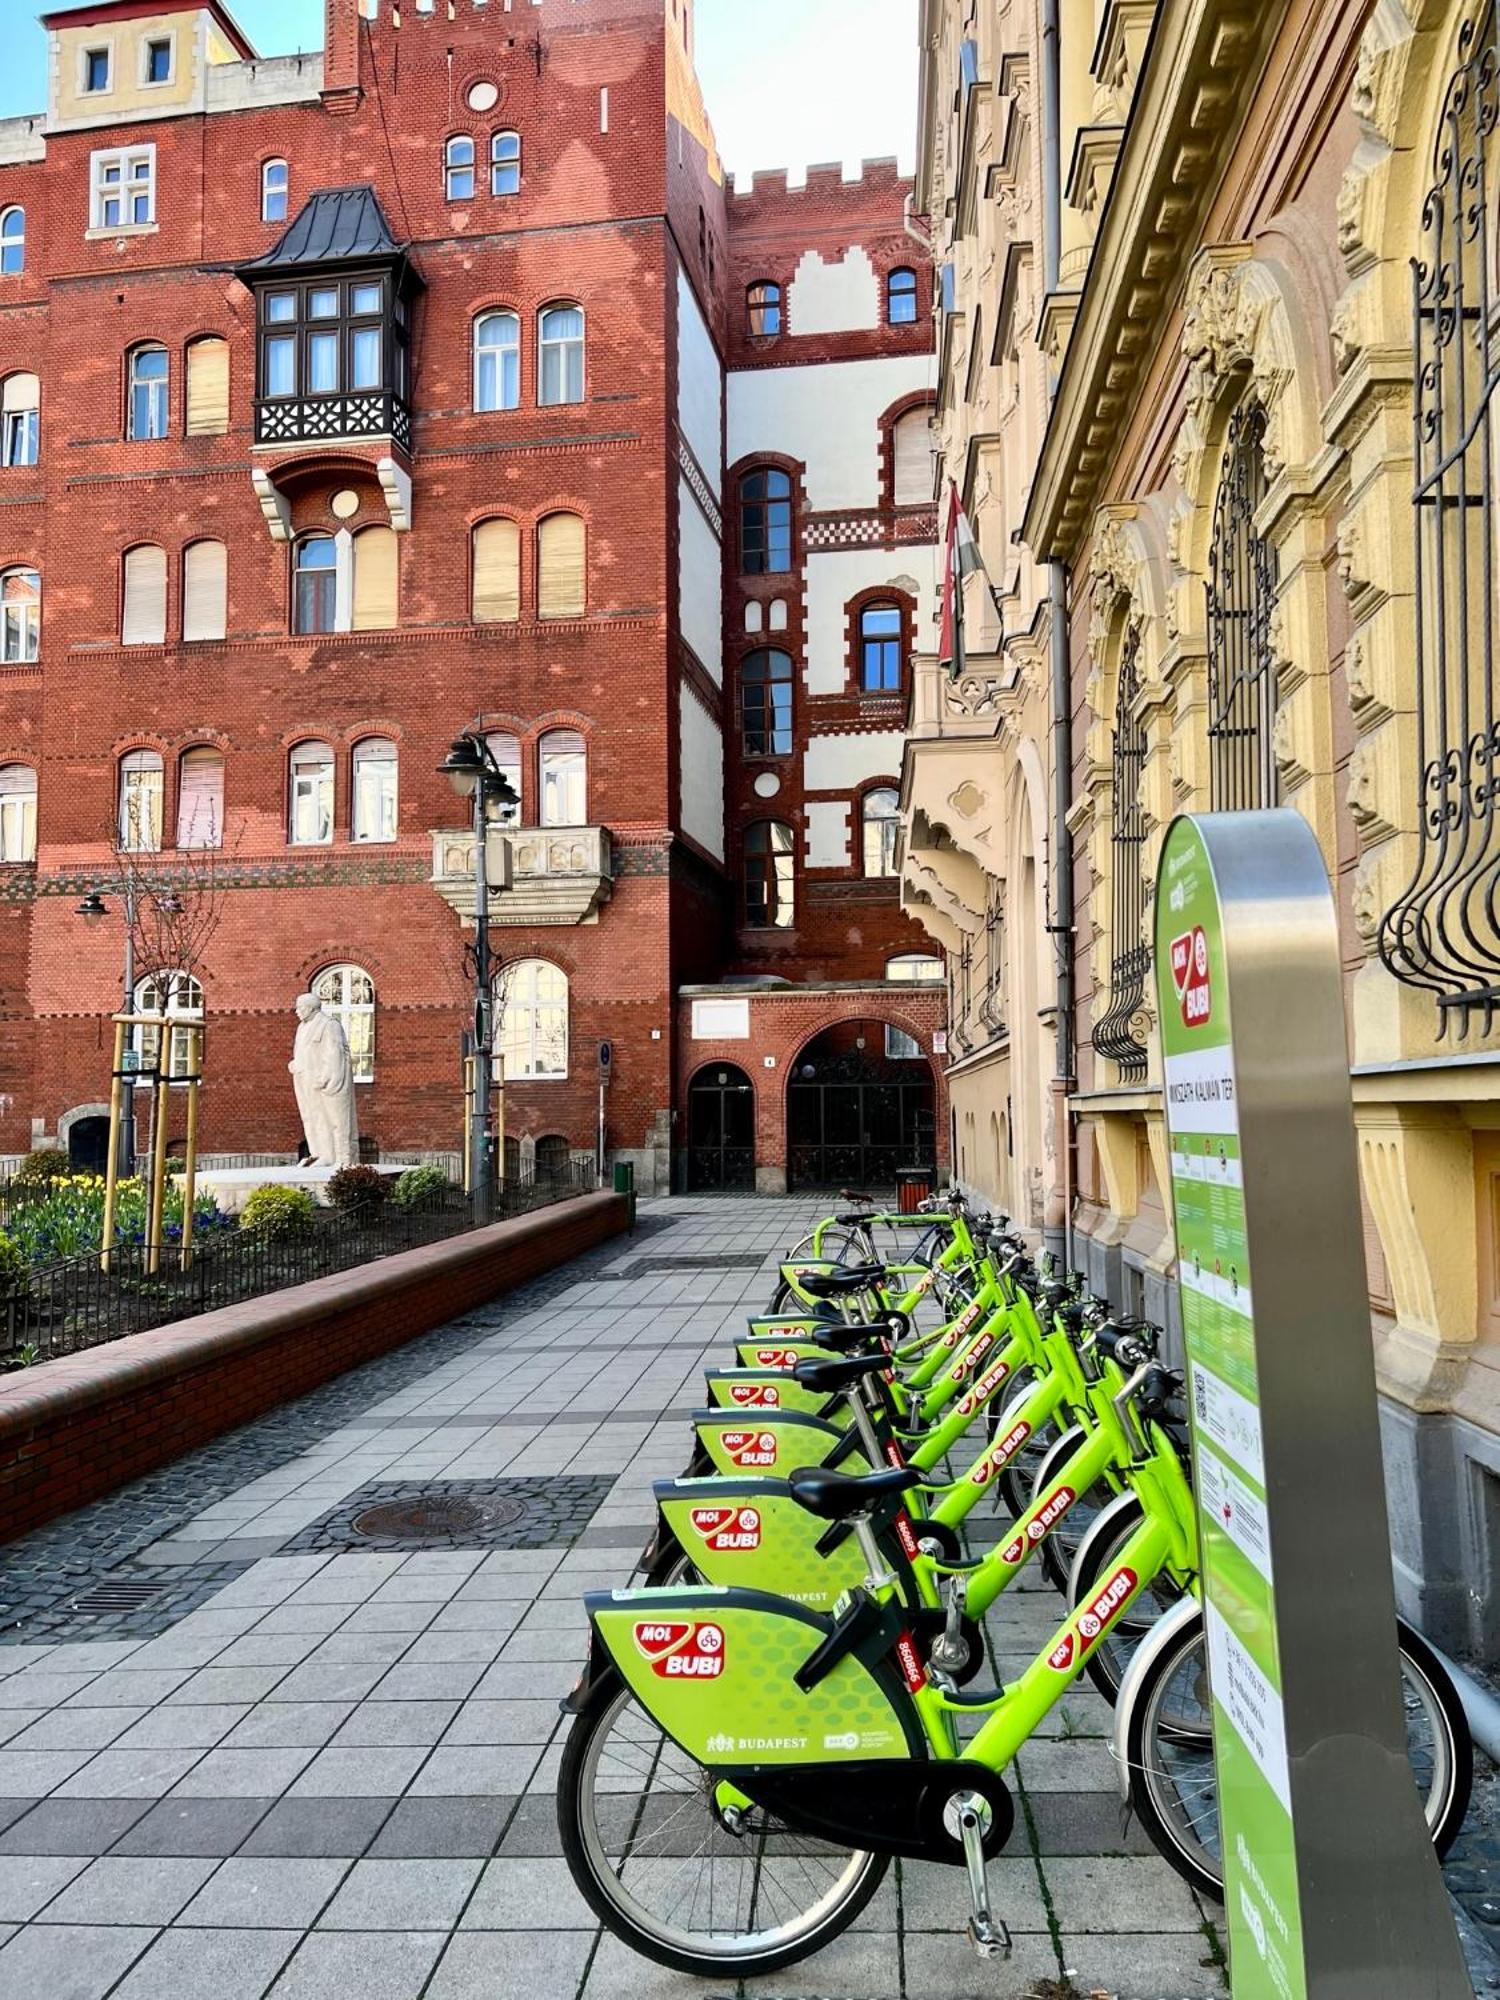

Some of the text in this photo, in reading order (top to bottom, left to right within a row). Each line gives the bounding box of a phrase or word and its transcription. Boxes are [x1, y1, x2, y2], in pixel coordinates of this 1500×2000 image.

[1186, 983, 1209, 1019] BUBI
[983, 1365, 1007, 1391] BUBI
[733, 1387, 751, 1397] MOL
[725, 1434, 744, 1444] MOL
[1002, 1424, 1028, 1455] BUBI
[740, 1451, 775, 1465] BUBI
[695, 1511, 720, 1523] MOL
[1039, 1489, 1071, 1527] BUBI
[716, 1532, 759, 1548] BUBI
[1051, 1571, 1132, 1668] MOL BUBI
[640, 1626, 672, 1641] MOL
[665, 1655, 722, 1675] BUBI
[899, 1641, 920, 1682] 860866
[738, 1737, 808, 1750] BUDAPEST
